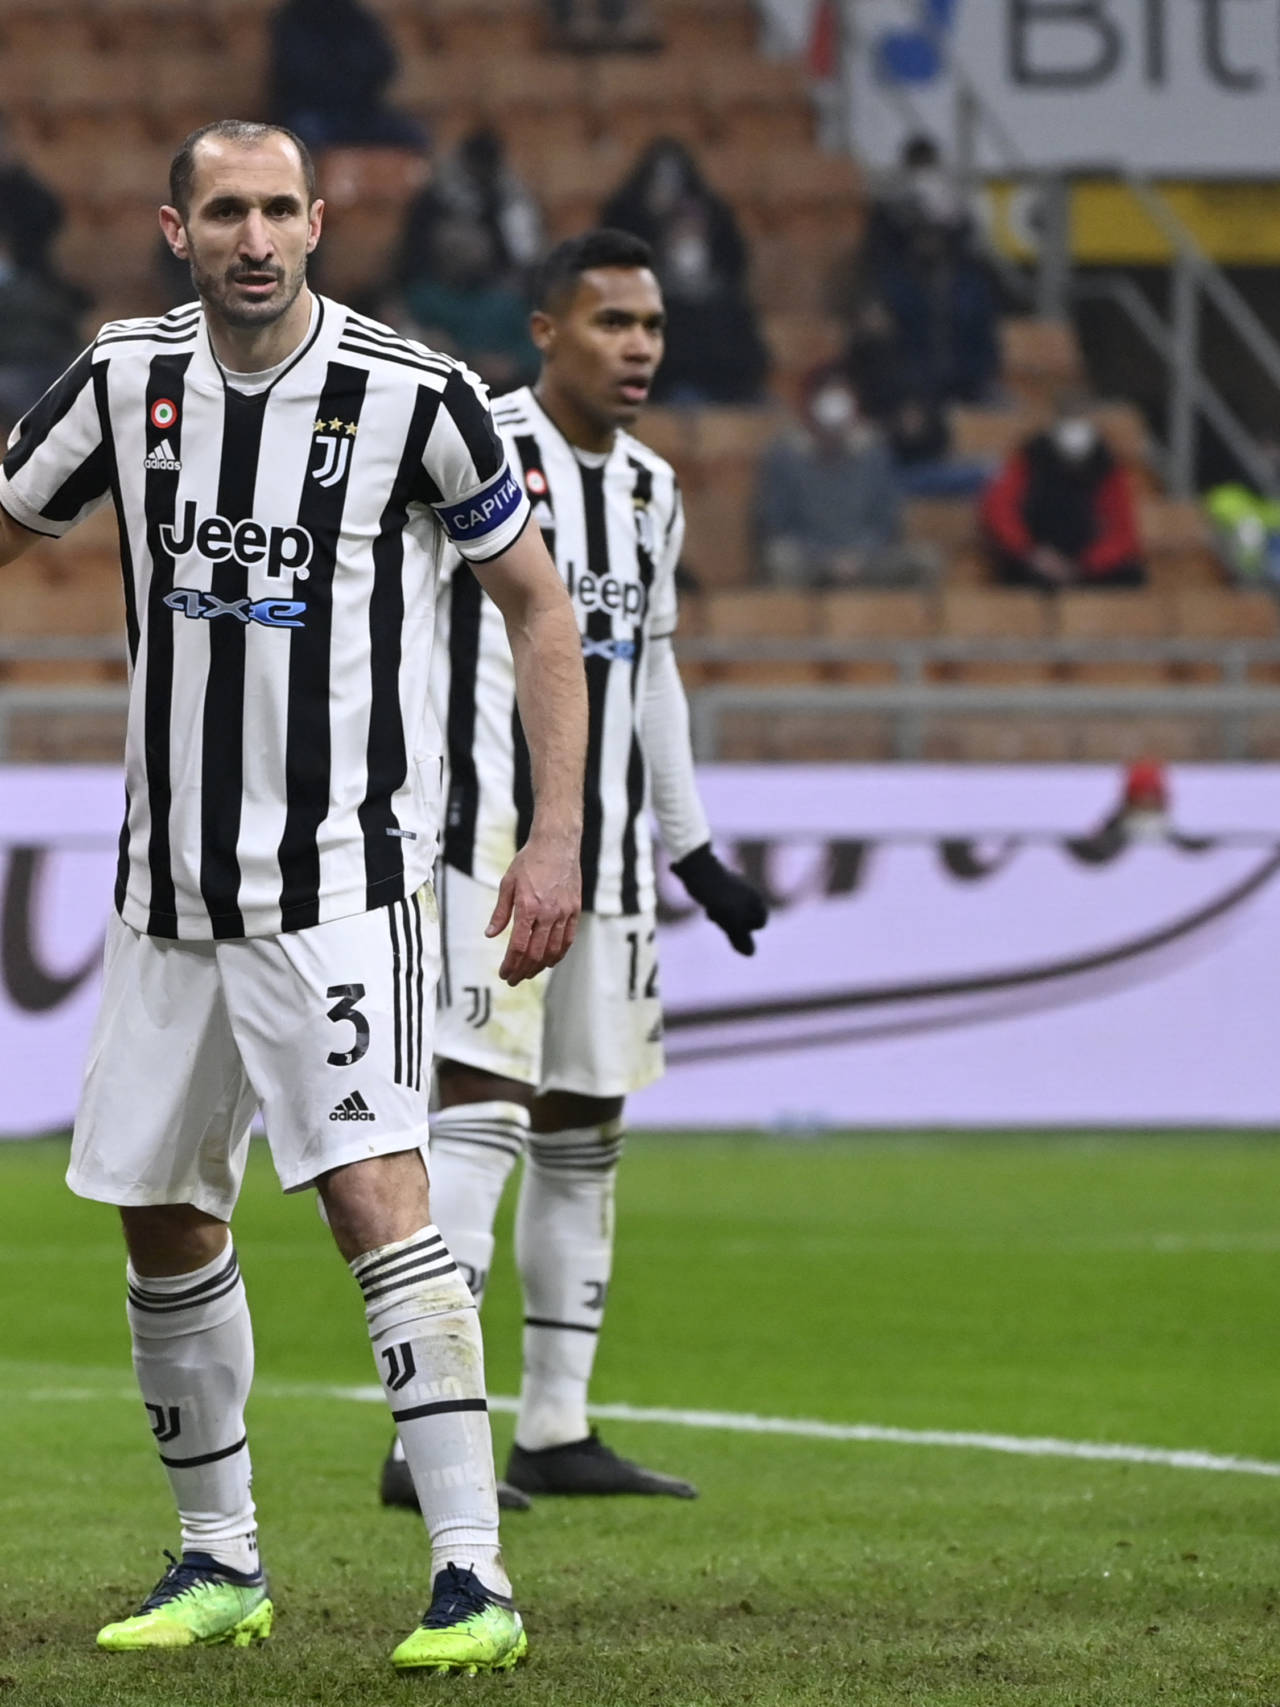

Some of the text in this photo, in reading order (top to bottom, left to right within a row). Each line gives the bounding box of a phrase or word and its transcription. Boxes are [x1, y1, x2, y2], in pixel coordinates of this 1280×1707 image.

[144, 458, 182, 470] adidas
[453, 475, 519, 530] CAPITA
[160, 499, 313, 580] Jeep
[326, 983, 370, 1067] 3
[328, 1110, 376, 1121] adidas
